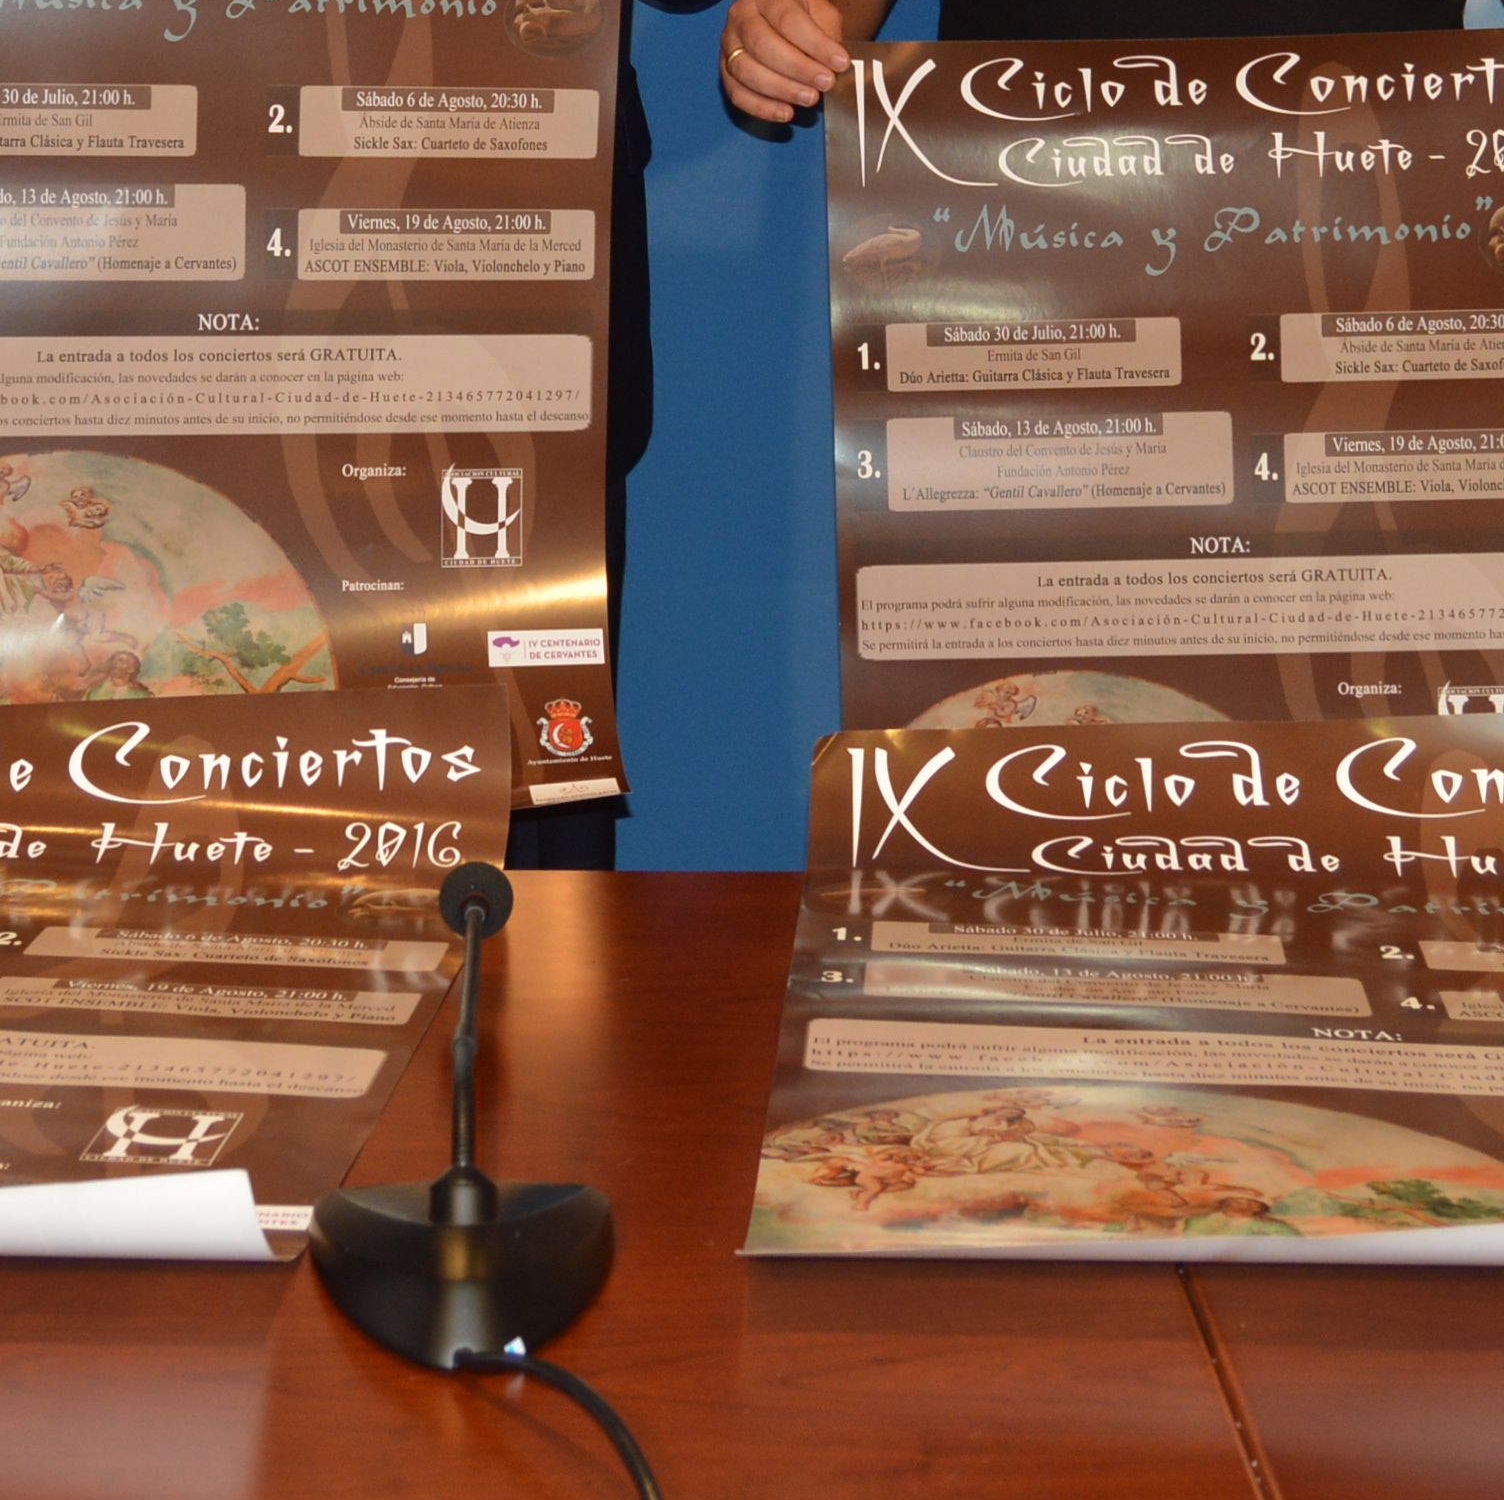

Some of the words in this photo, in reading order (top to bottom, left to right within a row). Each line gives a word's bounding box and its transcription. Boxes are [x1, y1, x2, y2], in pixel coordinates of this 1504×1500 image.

[356, 92, 403, 107] Sábado
[407, 92, 415, 107] 6
[418, 93, 434, 108] de
[438, 92, 487, 112] Agosto,
[491, 94, 526, 109] 20:30
[530, 94, 542, 109] h.
[852, 58, 998, 187] IX
[960, 58, 1126, 121] Ciclo
[1114, 55, 1207, 107] de
[354, 137, 389, 150] Sickle
[393, 137, 417, 150] Sax:
[421, 137, 469, 150] Cuarteto
[473, 138, 486, 150] de
[490, 138, 548, 152] Saxofones
[998, 136, 1164, 187] Ciudad
[1164, 136, 1235, 176] de
[1268, 132, 1413, 179] Huete
[197, 314, 260, 332] NOTA:
[37, 351, 54, 363] La
[59, 351, 112, 363] entrada
[117, 354, 125, 363] a
[129, 350, 168, 363] todos
[173, 350, 194, 363] los
[199, 350, 272, 363] conciertos
[277, 349, 305, 363] será
[310, 348, 402, 363] GRATUITA.
[962, 420, 1012, 438] Sábado,
[1016, 421, 1030, 436] 13
[1034, 420, 1050, 435] de
[1054, 420, 1101, 439] Agosto,
[1106, 419, 1140, 435] 21:00
[1144, 418, 1156, 433] h.
[342, 463, 407, 481] Organiza:
[1190, 535, 1251, 556] NOTA:
[342, 580, 404, 592] Patrocinan:
[528, 639, 537, 648] IV
[540, 638, 600, 648] CENTENARIO
[529, 651, 541, 660] DE
[544, 650, 597, 659] CERVANTES
[1338, 680, 1402, 699] Organiza:
[68, 721, 482, 805] Conciertos
[847, 745, 1031, 873] IX
[985, 743, 1196, 820] Ciclo
[1179, 740, 1301, 807] de
[91, 821, 274, 864] Huete
[338, 821, 462, 871] 2016
[1029, 834, 1247, 875] Ciudad
[1249, 837, 1341, 873] de
[1312, 1027, 1402, 1043] NOTA:
